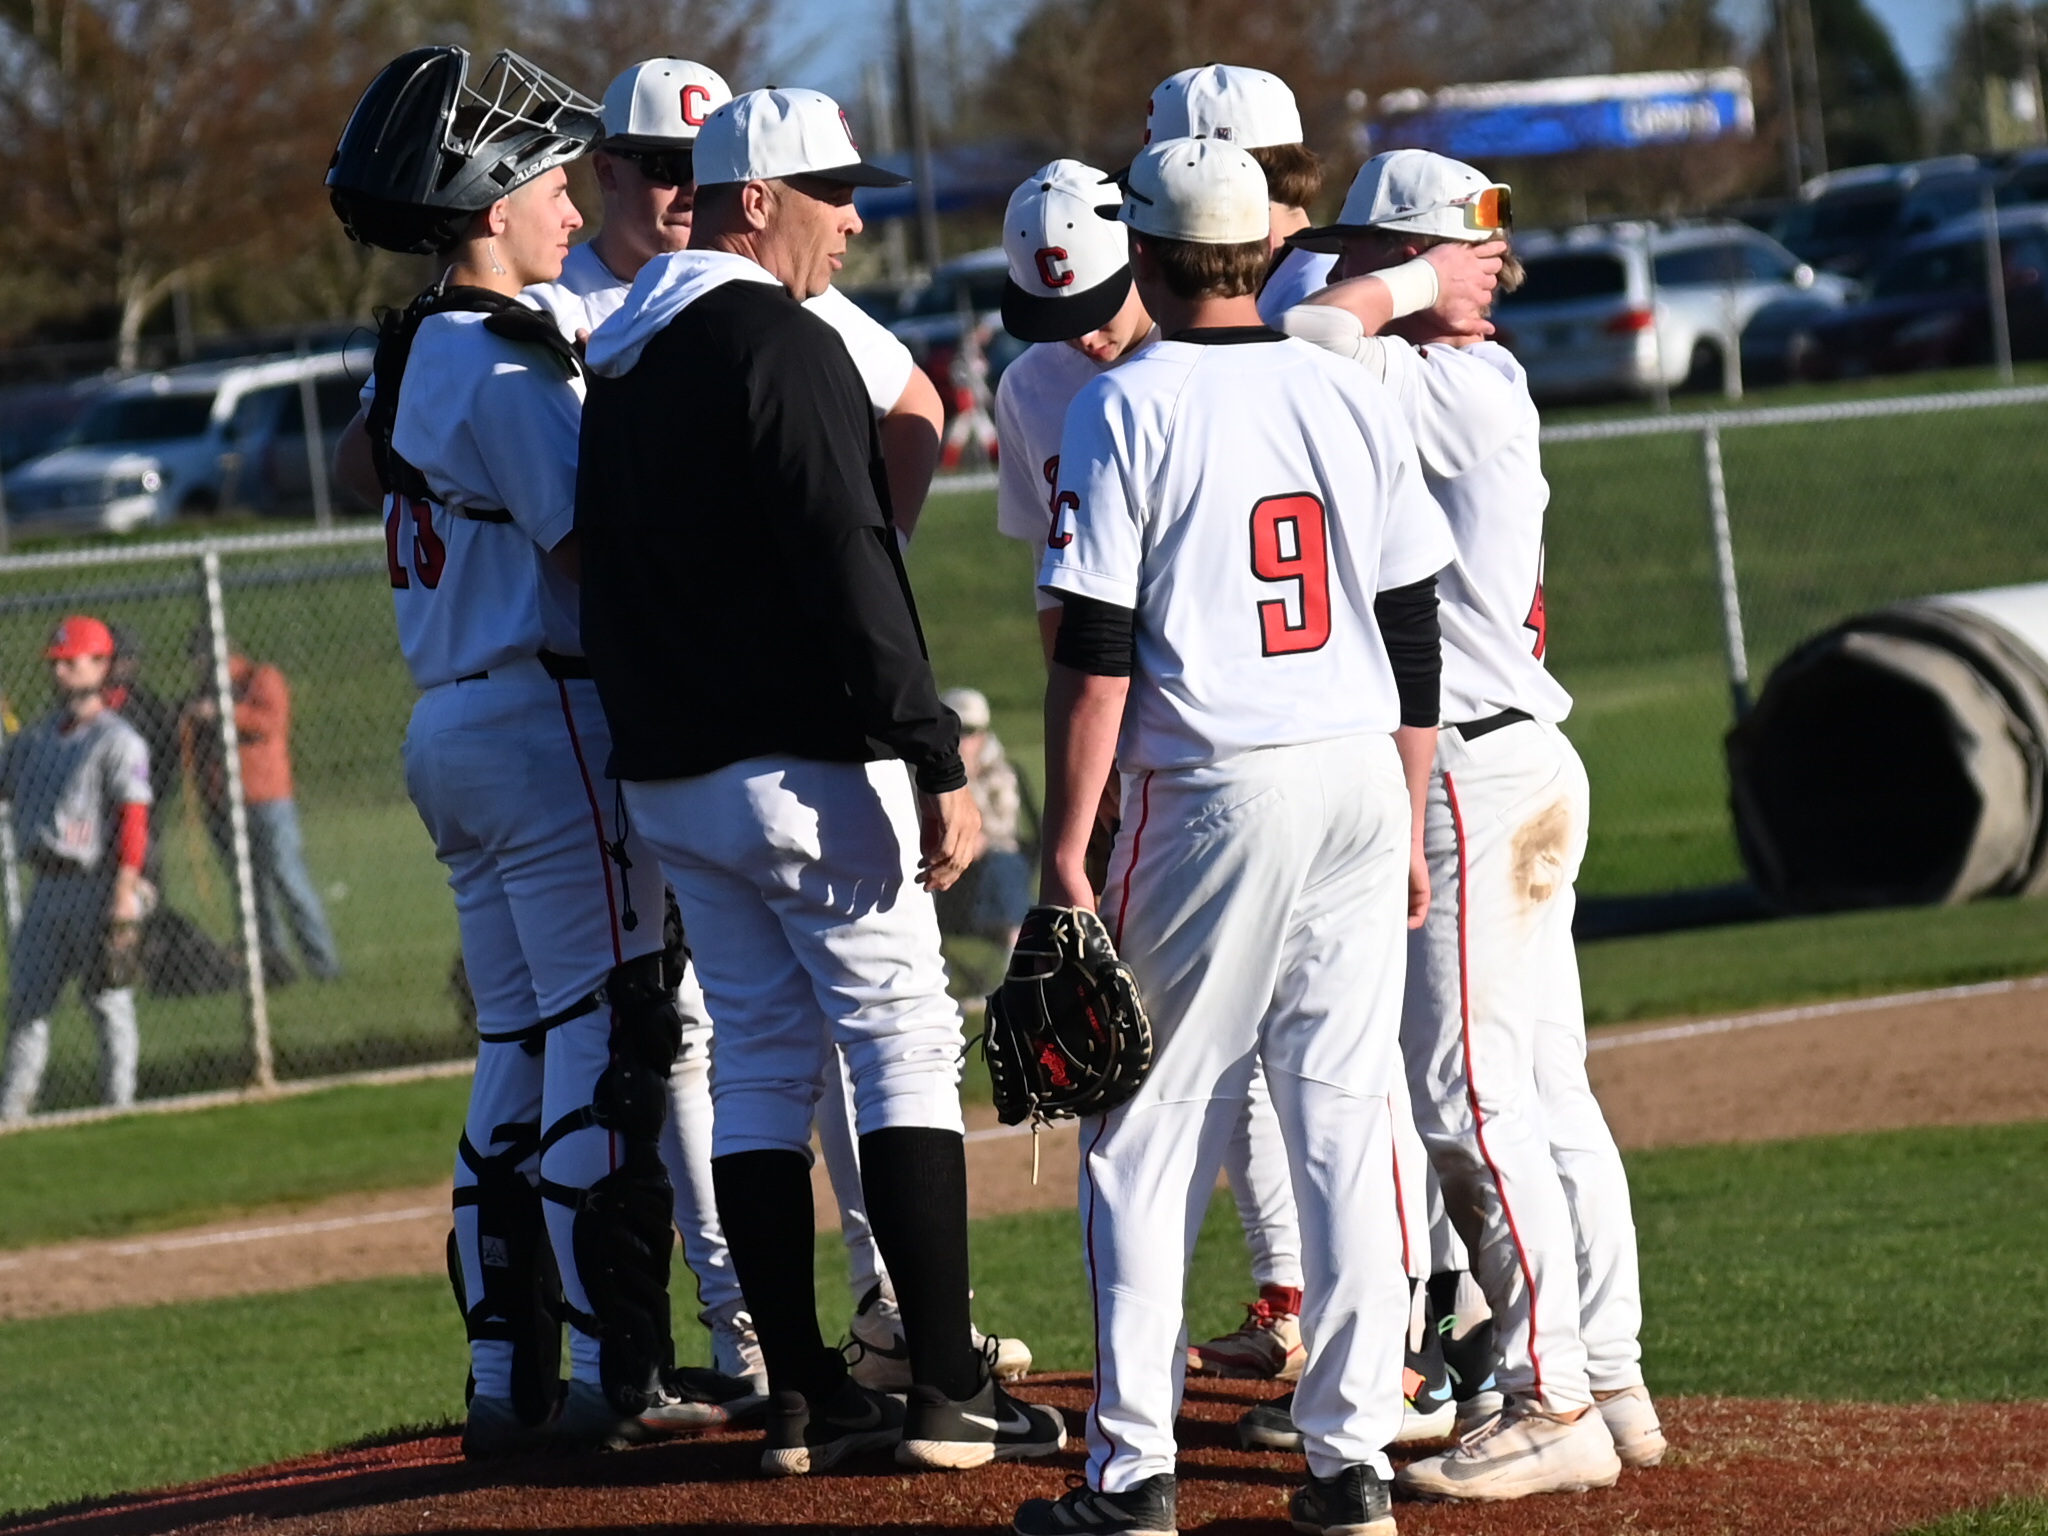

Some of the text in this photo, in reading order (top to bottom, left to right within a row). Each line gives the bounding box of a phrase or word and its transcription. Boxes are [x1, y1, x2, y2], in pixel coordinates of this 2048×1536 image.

[679, 84, 711, 126] C
[1034, 246, 1075, 289] C
[1048, 490, 1080, 549] C
[1249, 491, 1331, 657] 9
